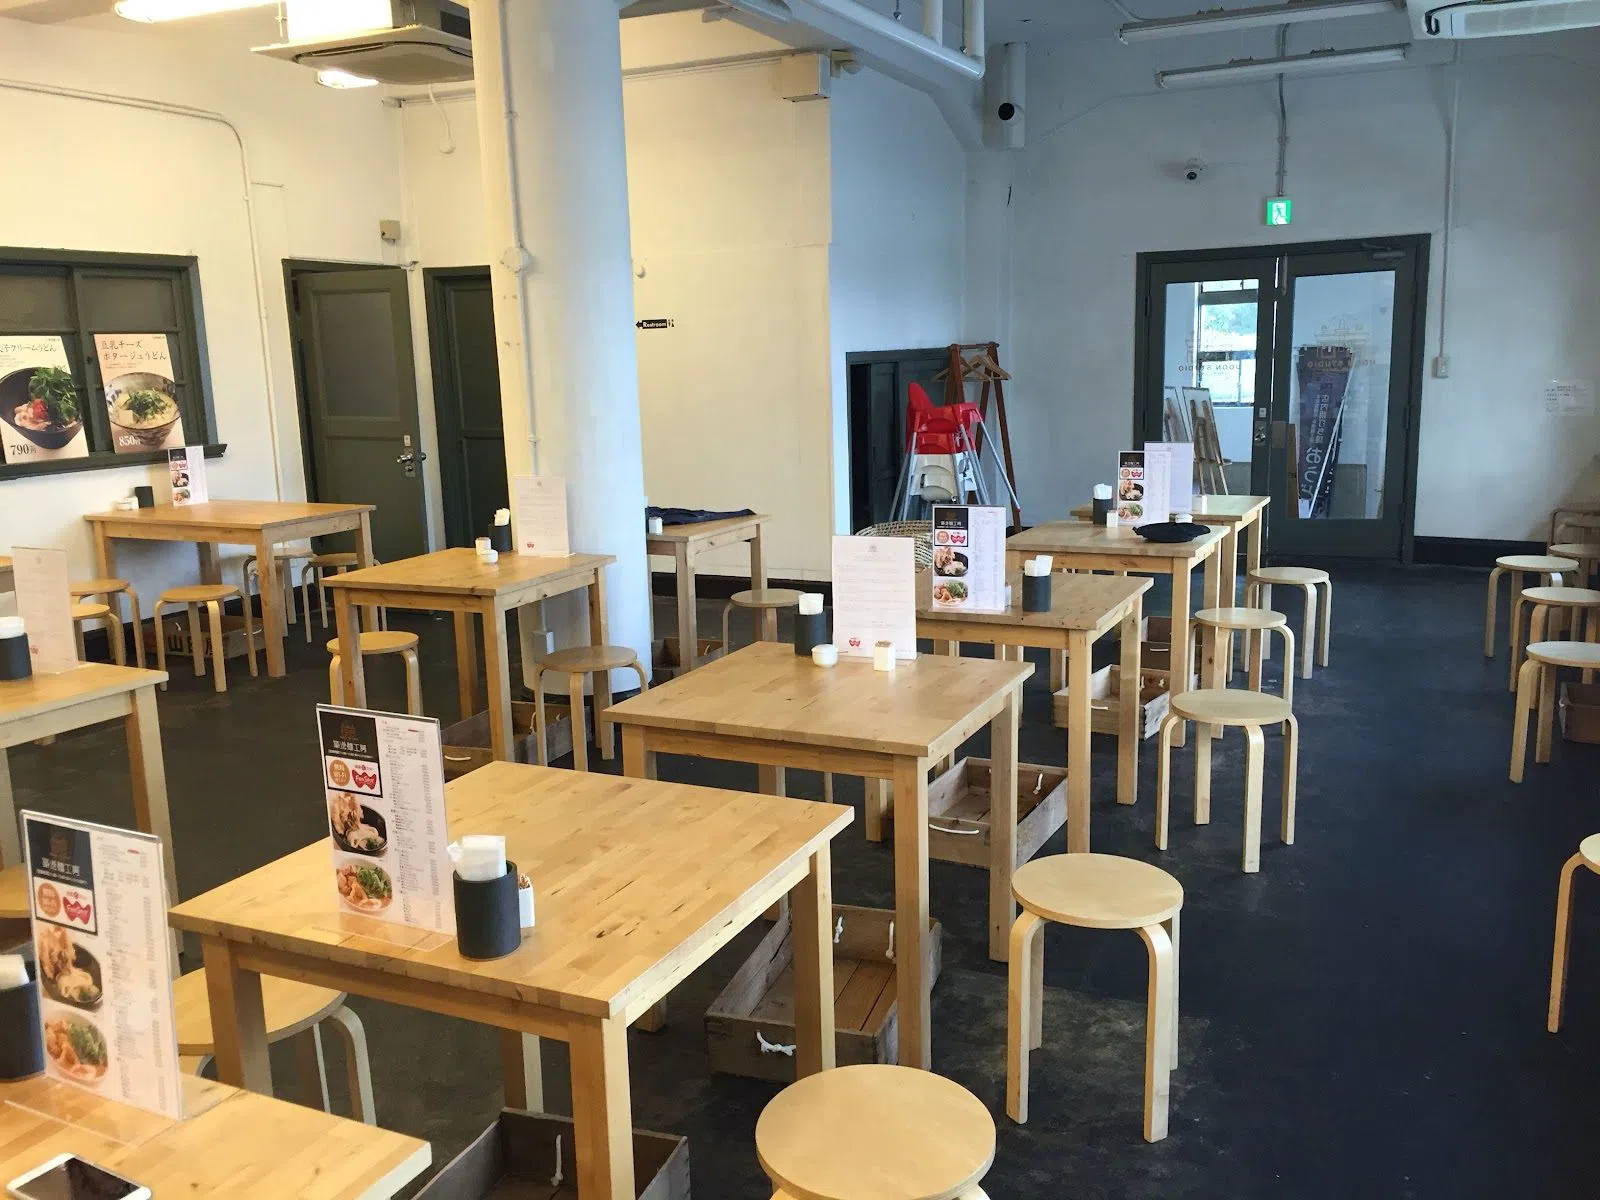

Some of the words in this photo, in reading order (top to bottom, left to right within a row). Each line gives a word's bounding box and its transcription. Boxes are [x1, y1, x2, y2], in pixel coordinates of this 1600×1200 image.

[101, 339, 143, 350] 豆乳チーズ
[103, 350, 167, 361] ポタージュうどん
